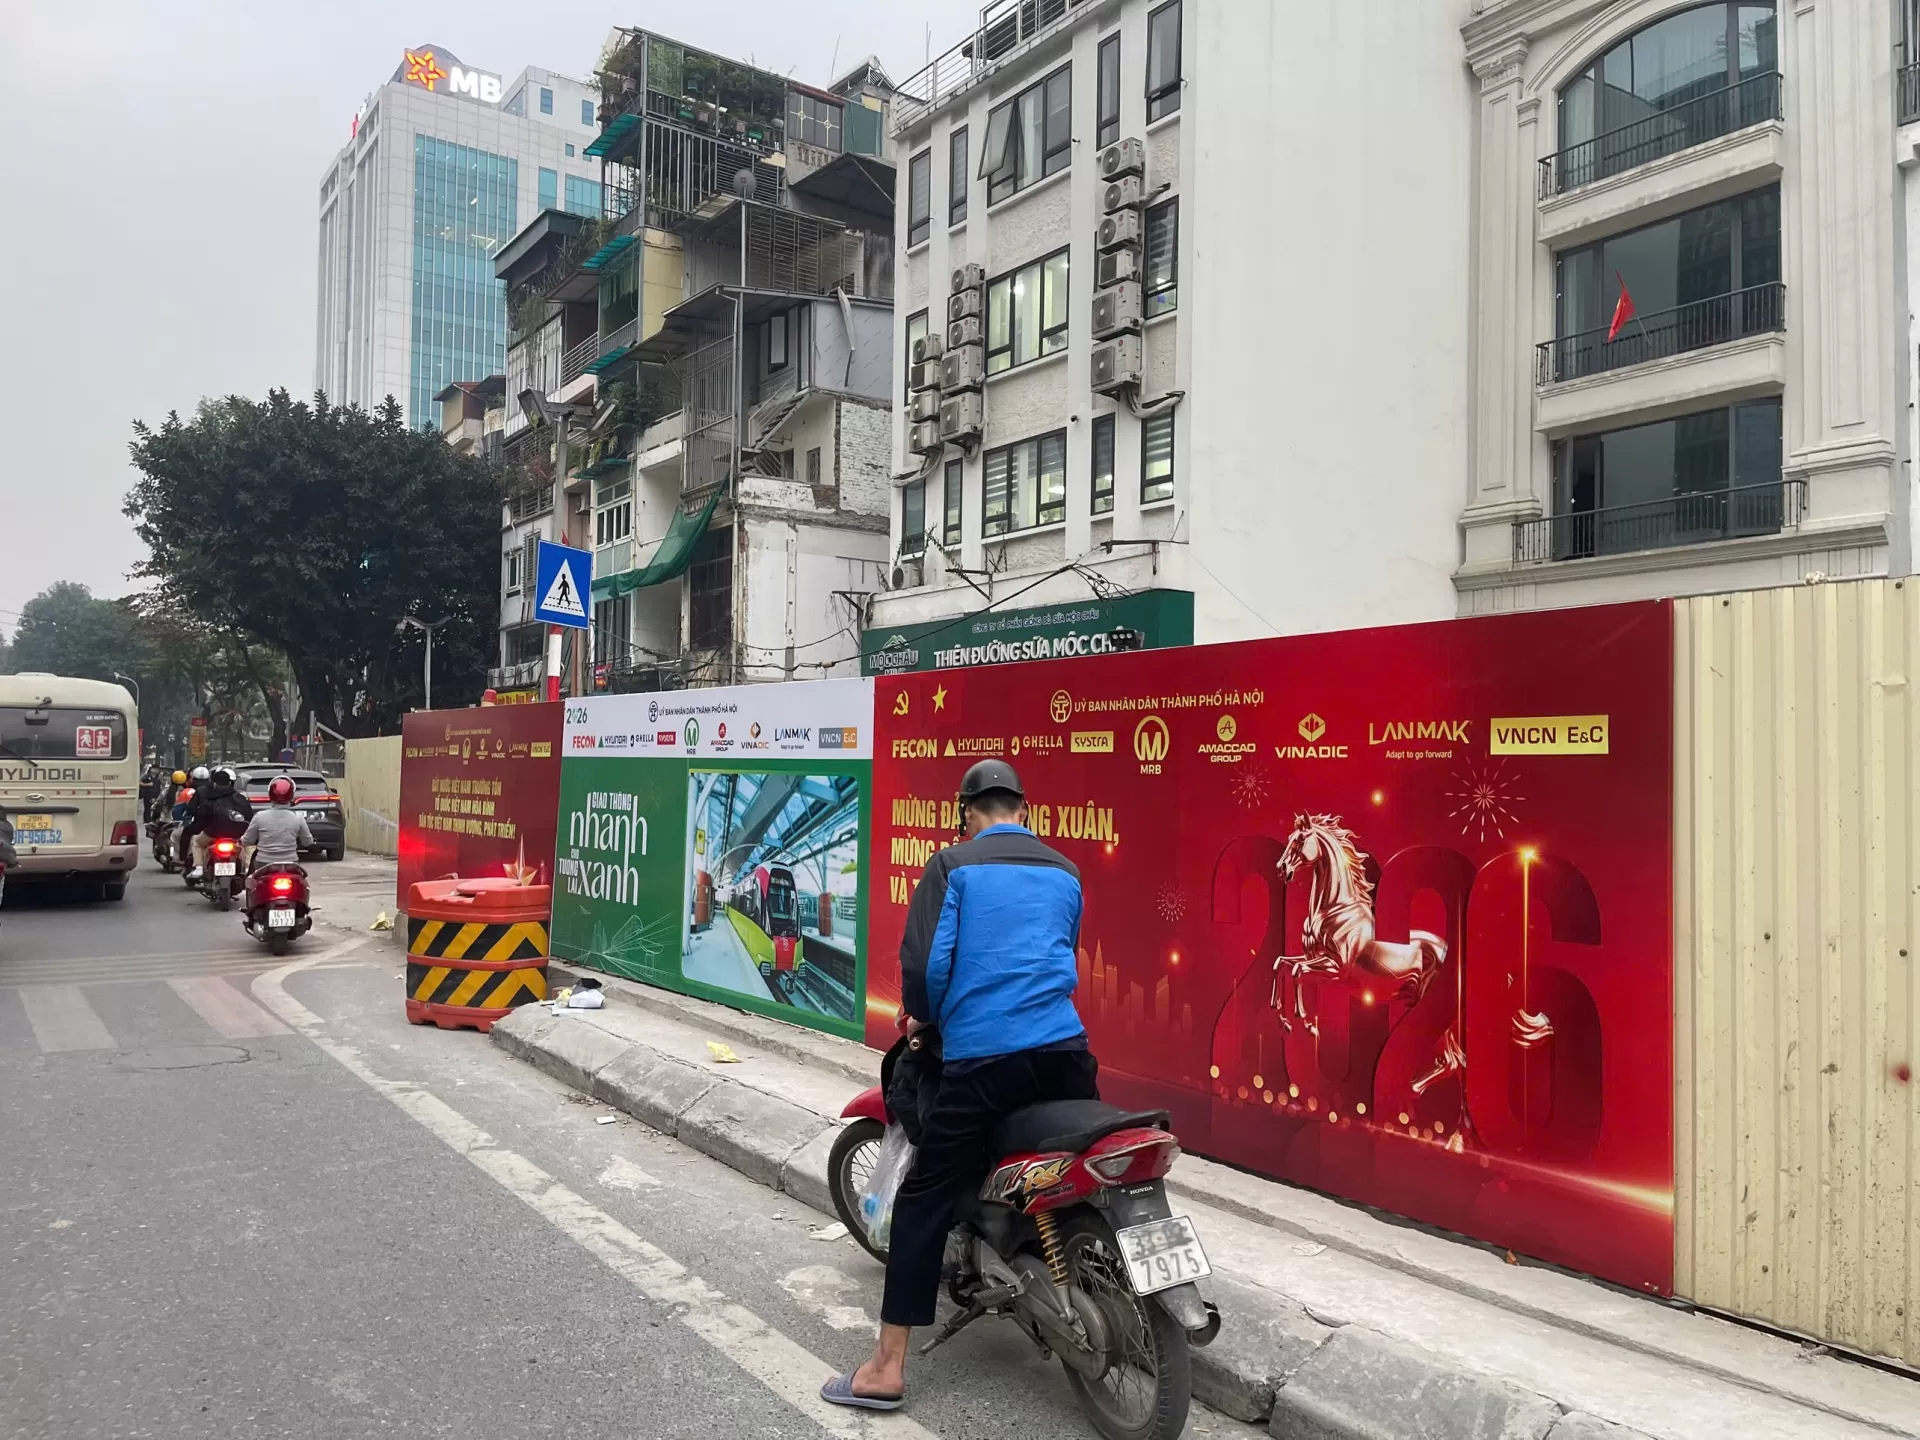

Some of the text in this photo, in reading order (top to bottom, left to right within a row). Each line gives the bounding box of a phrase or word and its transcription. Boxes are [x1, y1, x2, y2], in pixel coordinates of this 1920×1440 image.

[449, 66, 501, 103] MB
[934, 644, 971, 667] THIÊN
[1022, 635, 1050, 659] SỮA
[870, 651, 891, 670] MỘC
[1088, 700, 1107, 712] BAN
[1109, 696, 1136, 711] NHÂN
[1138, 695, 1159, 710] DÂN
[1161, 692, 1197, 709] THÀNH
[1199, 688, 1222, 707] PHỐ
[1224, 688, 1241, 706] HÀ
[1243, 688, 1264, 707] NỘI
[604, 735, 628, 744] HYUNDAI
[774, 728, 811, 742] LANMAK
[820, 733, 841, 743] VNCN
[1369, 720, 1470, 745] LANMAK
[1497, 726, 1603, 744] VNCN E&C
[572, 735, 596, 749] FECON
[741, 741, 770, 749] VINADIC
[892, 739, 938, 758] FECON
[958, 738, 1004, 750] HYUNDAI
[1023, 736, 1064, 748] GHELLA
[1198, 743, 1256, 753] AMACCAO
[1210, 755, 1242, 763] GROUP
[1275, 746, 1348, 759] VINADIC
[1385, 750, 1452, 760] Adapt to go forward
[1140, 764, 1161, 775] MRB
[591, 790, 632, 811] GIAO THÔNG
[570, 792, 648, 856] nhanh
[892, 794, 936, 829] MỪNG
[940, 791, 966, 830] ĐẢ
[1056, 800, 1120, 847] XUÂN,
[12, 829, 62, 844] 9H-956.52
[891, 832, 935, 868] MỪNG
[578, 853, 639, 906] xanh
[890, 871, 909, 906] VÀ
[1130, 1185, 1154, 1195] HONDA
[1140, 1248, 1201, 1287] 7975
